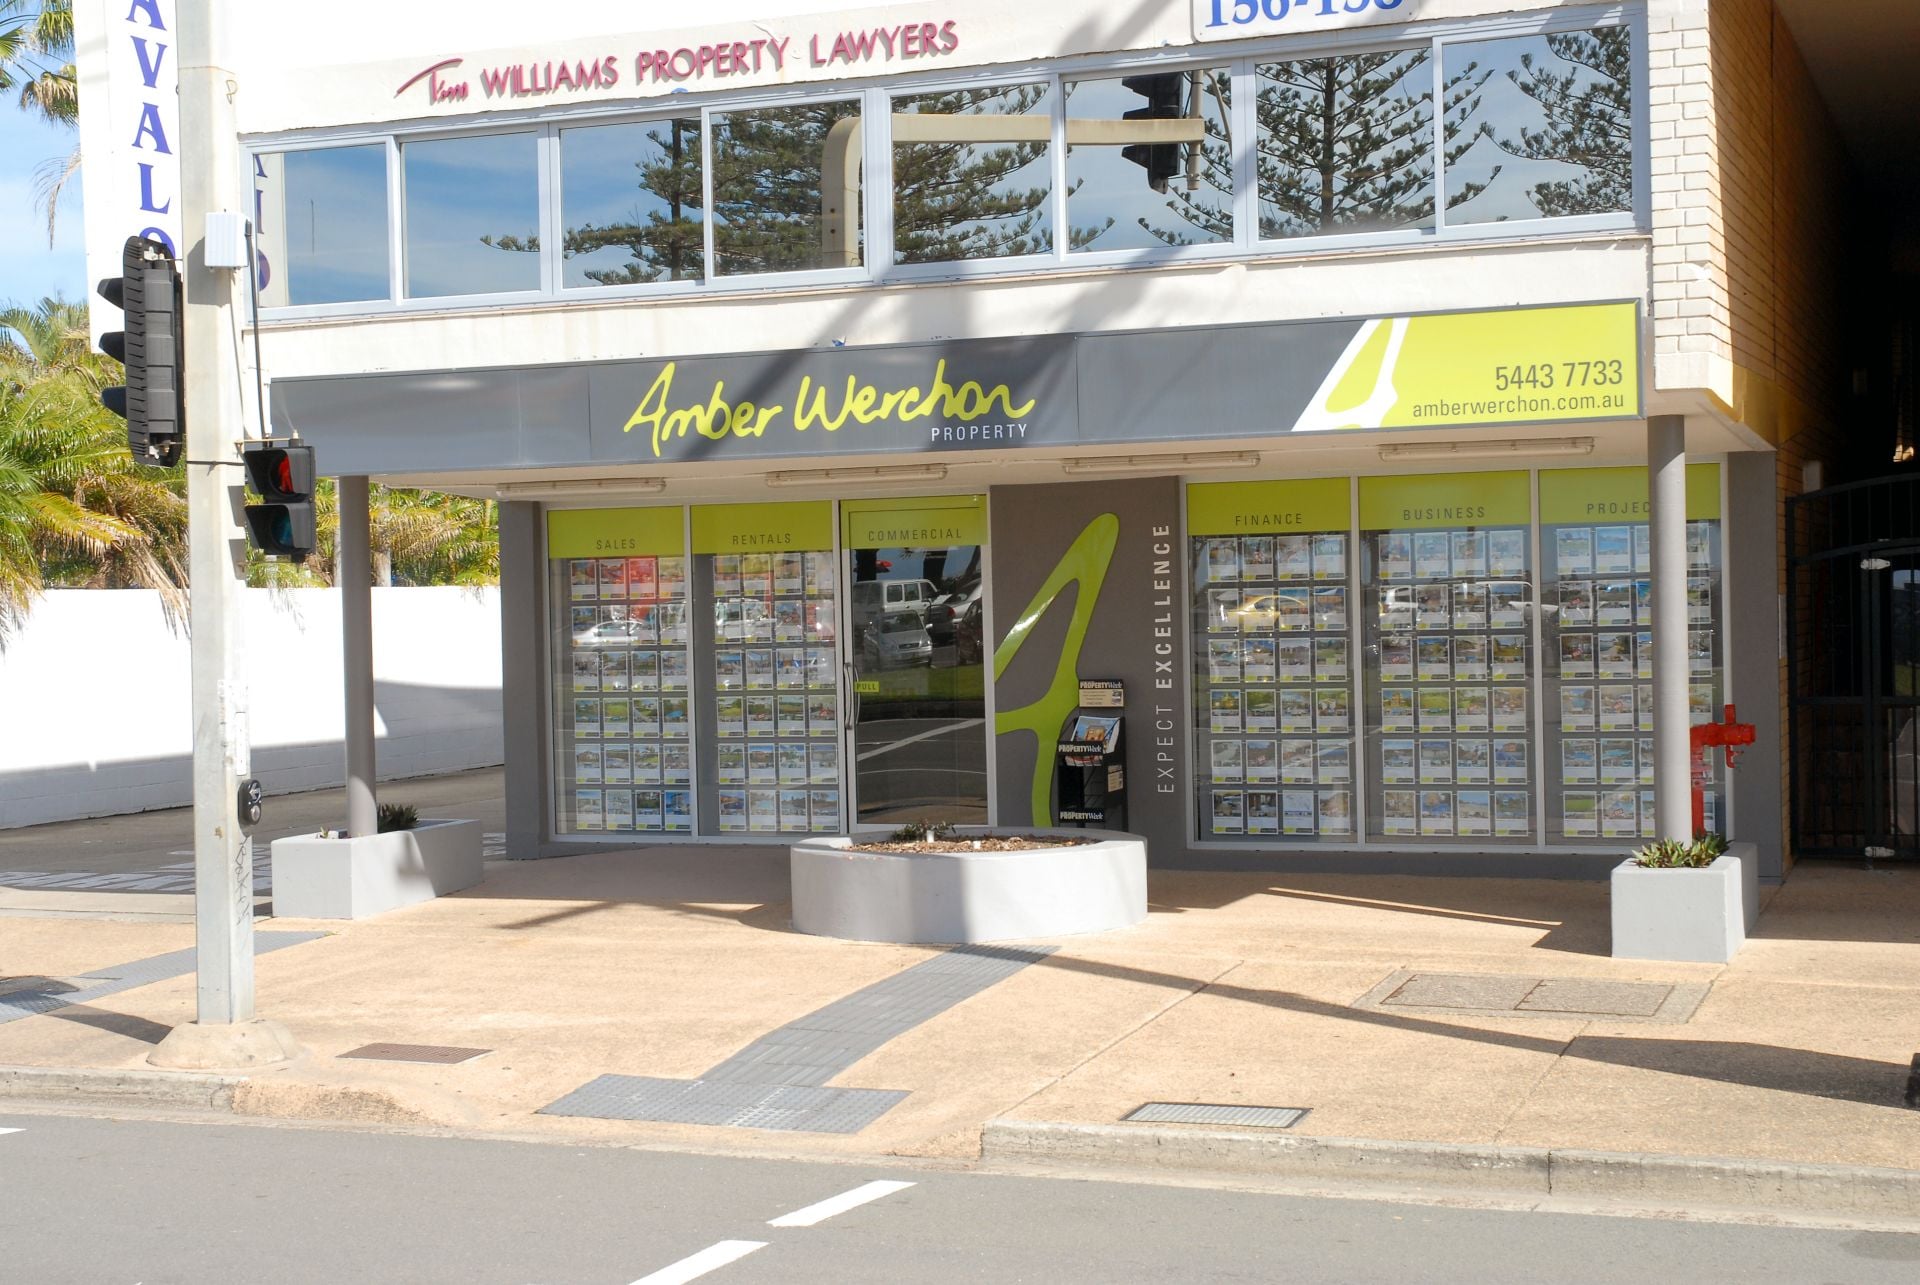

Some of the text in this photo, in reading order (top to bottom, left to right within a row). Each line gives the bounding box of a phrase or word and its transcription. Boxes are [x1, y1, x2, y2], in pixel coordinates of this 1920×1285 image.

[396, 20, 959, 103] Tim WILLIAMS PROPERTY LAWYERS
[1495, 360, 1623, 391] 5443 7733
[624, 359, 1035, 457] Amber Werchon
[1412, 393, 1624, 417] amberwerchon.com.au
[931, 423, 1028, 442] PROPERTY
[1402, 506, 1486, 521] BUSINESS
[1586, 502, 1650, 515] PROJEC
[1234, 512, 1304, 526] FINANCE
[732, 533, 792, 546] RENTALS
[868, 528, 962, 542] COMMERCIAL
[596, 538, 637, 551] SALES
[1153, 525, 1174, 793] EXPECT EXCELLENCE
